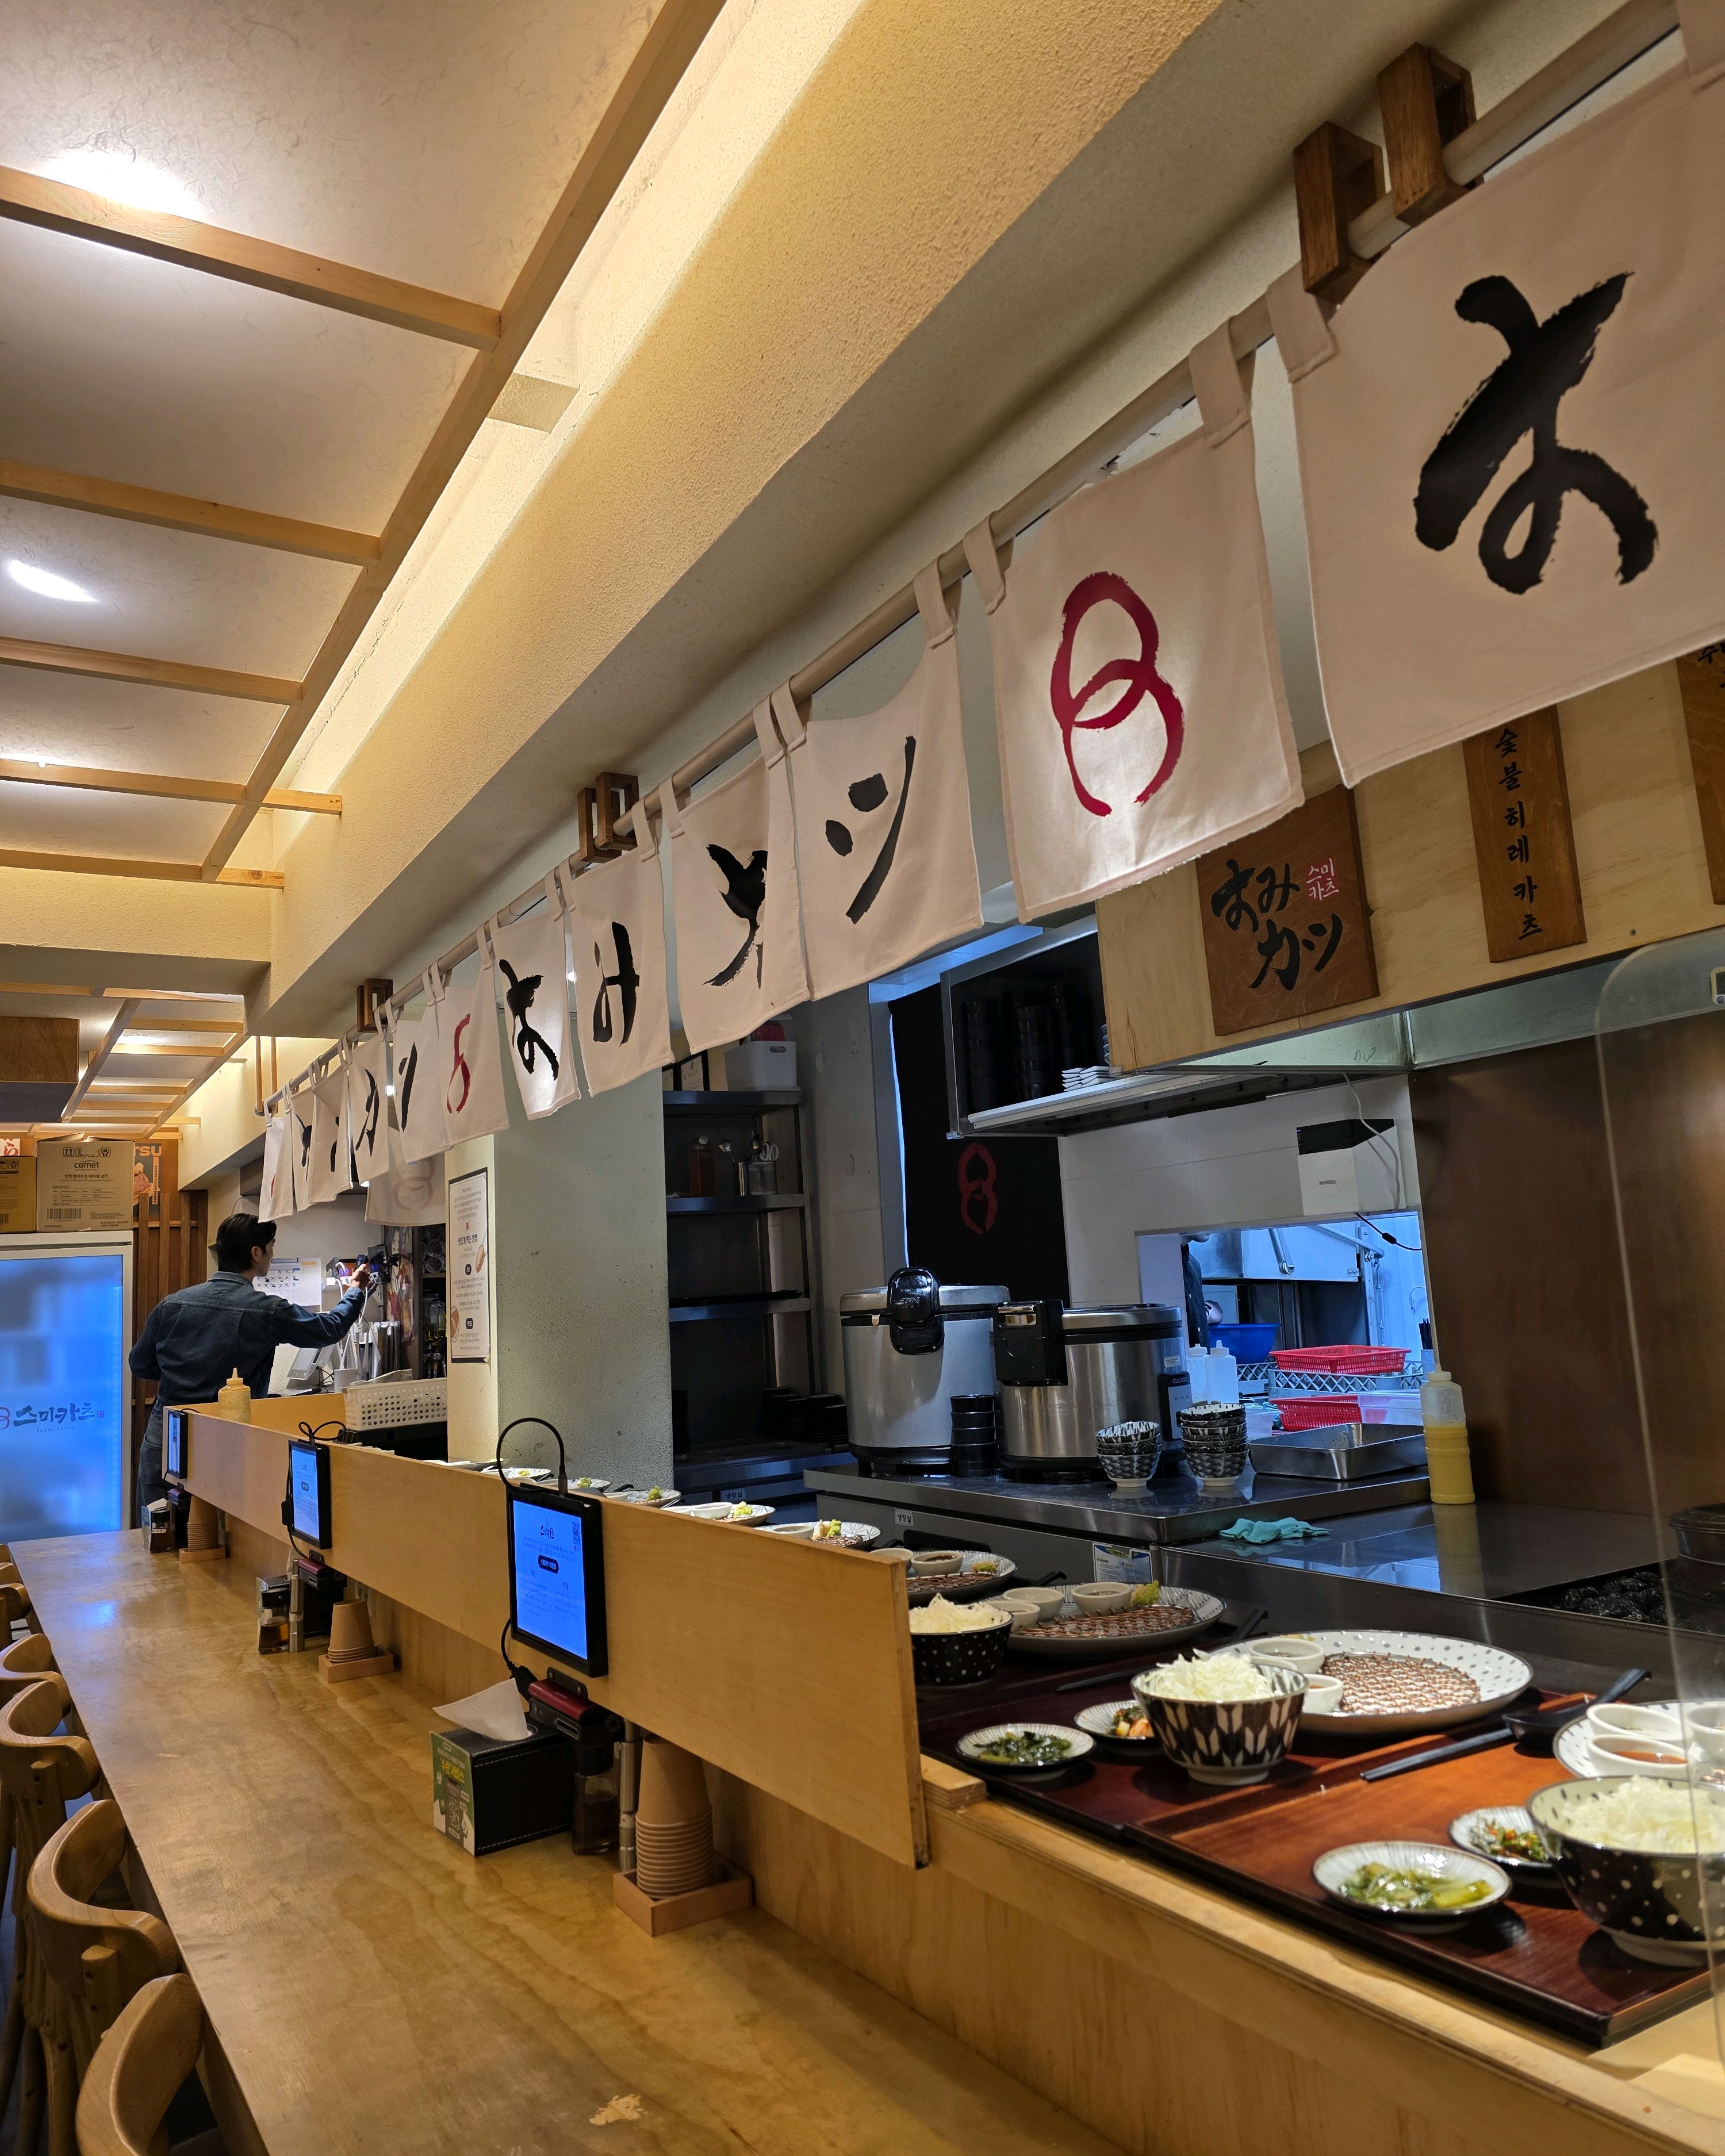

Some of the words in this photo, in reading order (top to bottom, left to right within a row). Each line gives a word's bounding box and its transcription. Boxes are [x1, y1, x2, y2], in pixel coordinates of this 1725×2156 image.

[472, 1233, 478, 1242] 방법
[13, 1402, 95, 1426] 스미카츠
[897, 1513, 911, 1524] 냉장실
